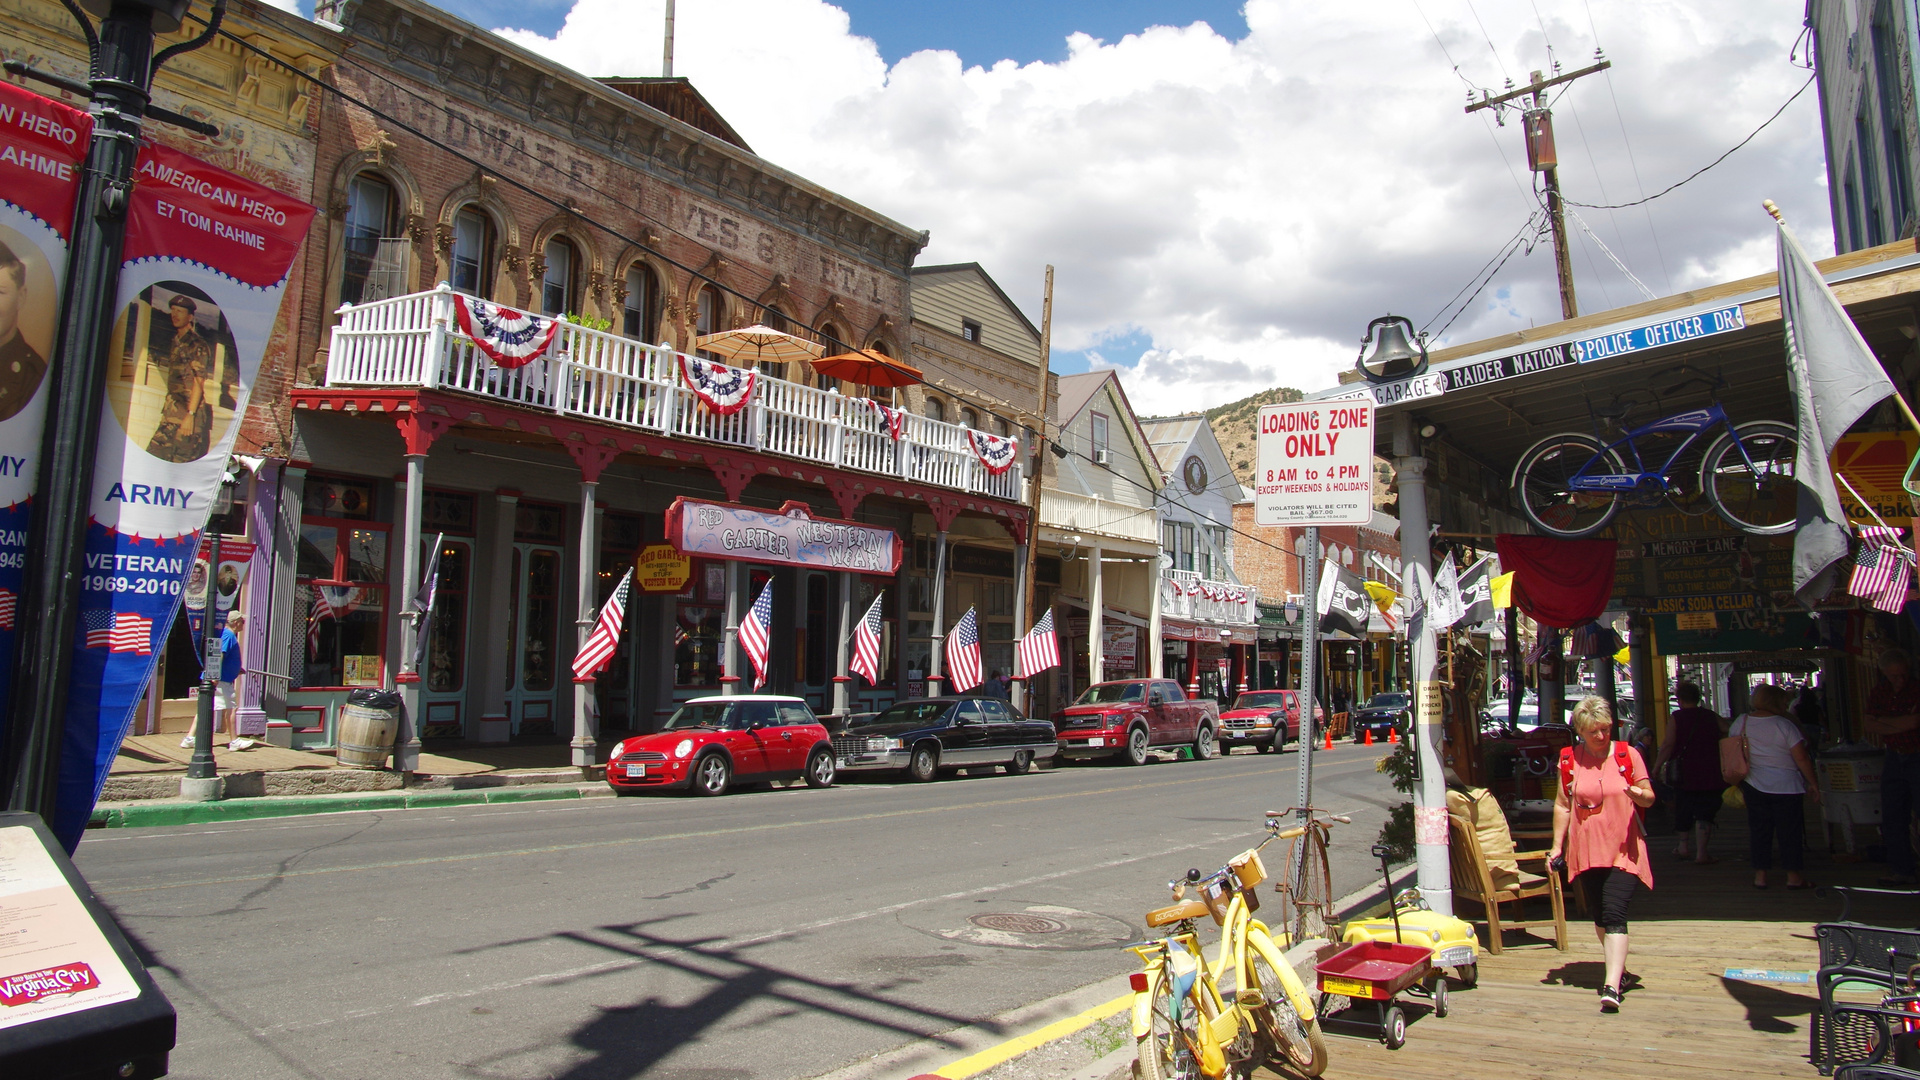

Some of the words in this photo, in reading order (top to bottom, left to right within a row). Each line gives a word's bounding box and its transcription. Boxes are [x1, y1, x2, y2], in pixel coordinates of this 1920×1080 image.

[20, 113, 77, 146] HERO
[140, 160, 237, 208] AMERICAN
[241, 199, 286, 227] HERO
[156, 200, 176, 218] E7
[180, 209, 210, 232] TOM
[214, 220, 265, 251] RAHME
[1586, 331, 1636, 359] POLICE
[1644, 316, 1703, 346] OFFICER
[1712, 308, 1735, 331] DR
[1452, 358, 1504, 389] RAIDER
[1512, 344, 1566, 374] NATION
[1375, 378, 1430, 404] GARAGE
[1262, 410, 1320, 434] LOADING
[1329, 408, 1368, 430] ZONE
[1285, 432, 1340, 458] ONLY
[1266, 469, 1274, 482] 8
[1278, 468, 1297, 482] AM
[1305, 468, 1318, 480] to
[1326, 466, 1334, 479] 4
[1339, 465, 1359, 478] PM
[104, 482, 194, 510] ARMY
[1258, 484, 1283, 495] EXCEPT
[1284, 483, 1322, 493] WEEKENDS
[1326, 483, 1331, 492] &
[1333, 481, 1369, 492] HOLIDAYS
[1897, 494, 1909, 502] BY
[699, 508, 724, 530] RED
[1843, 503, 1913, 518] Kodak
[722, 528, 790, 558] GARTER
[797, 522, 883, 558] WESTERN
[1652, 540, 1698, 556] MEMORY
[1706, 536, 1736, 552] LANE
[86, 553, 182, 574] VETERAN
[640, 550, 655, 565] RED
[657, 550, 687, 562] GARTER
[829, 548, 883, 572] WEAR
[81, 576, 182, 596] 1969-2010
[1688, 596, 1714, 612] SODA
[1716, 594, 1754, 610] CELLAR
[0, 980, 61, 998] Virginia
[55, 969, 89, 986] City
[41, 986, 72, 996] NEVADA
